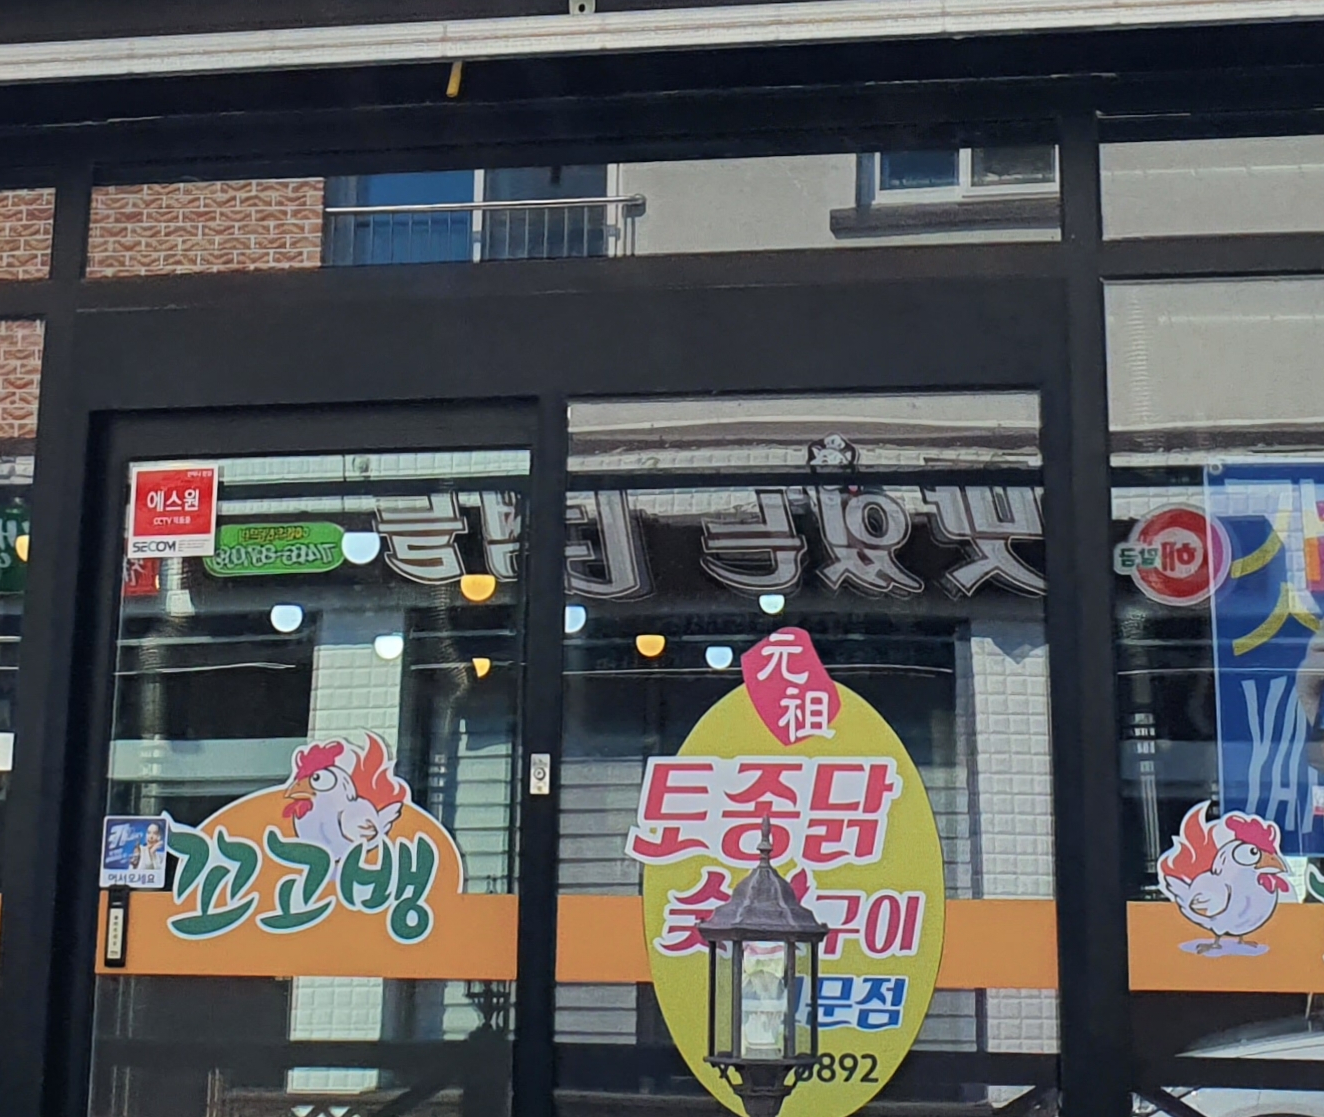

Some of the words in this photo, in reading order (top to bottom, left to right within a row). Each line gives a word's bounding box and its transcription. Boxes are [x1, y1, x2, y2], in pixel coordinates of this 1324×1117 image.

[147, 488, 199, 512] 에스원
[132, 540, 176, 553] SECOM
[757, 633, 837, 743] 元祖
[632, 763, 894, 864] 토종닭
[658, 868, 921, 957] 숯구이
[792, 976, 907, 1030] 문점
